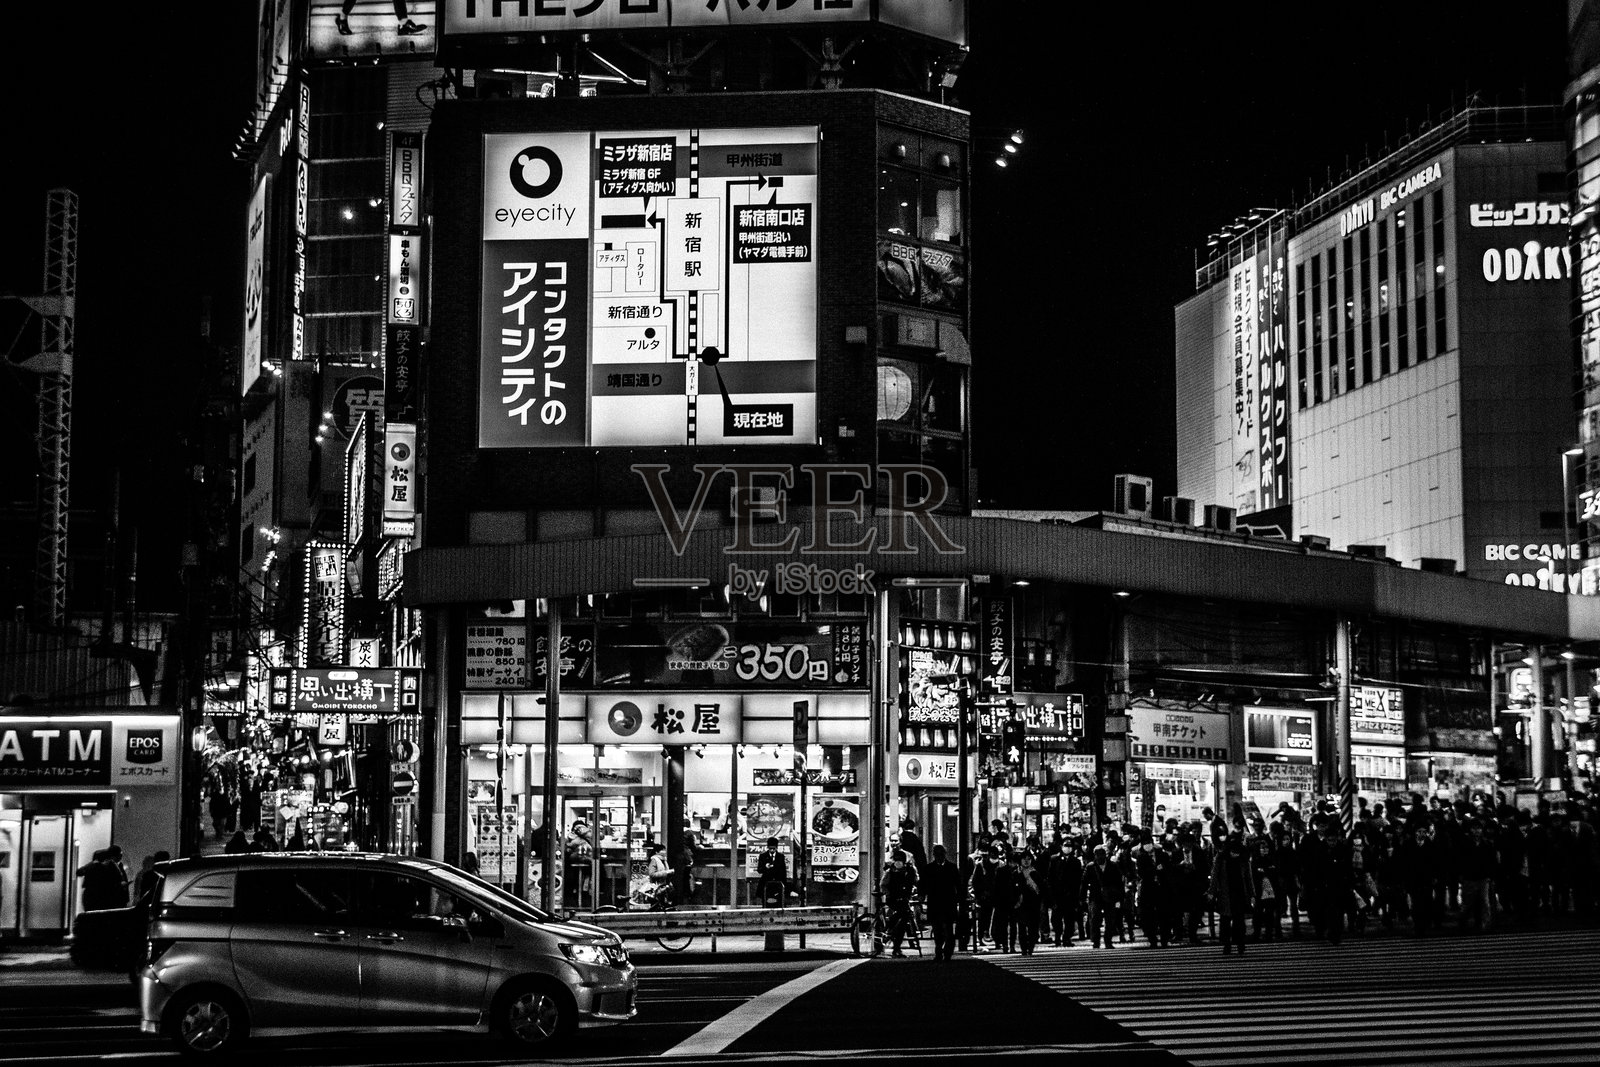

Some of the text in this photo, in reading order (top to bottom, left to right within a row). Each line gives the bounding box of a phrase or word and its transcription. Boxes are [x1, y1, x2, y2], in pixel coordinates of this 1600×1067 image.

[603, 143, 673, 162] ミラザ新宿店
[726, 152, 783, 168] 甲州街道
[603, 167, 661, 180] ミラザ新宿 6F
[400, 151, 415, 223] BBQフェスタ
[602, 181, 675, 195] (アディダス向かい)
[1380, 187, 1398, 210] BIC
[1398, 162, 1442, 199] CAMERA
[494, 203, 576, 227] eyecity
[739, 208, 805, 227] 新宿南口店
[684, 211, 702, 278] 新宿駅
[738, 232, 792, 244] 甲州街道沿い
[738, 245, 809, 259] (ヤマダ電機手前)
[892, 243, 916, 262] BBQ
[636, 248, 645, 286] ロータリー
[608, 305, 663, 320] 新宿通り
[501, 262, 538, 427] アイシティ
[541, 262, 567, 427] コンタクトの
[626, 339, 660, 351] アルタ
[607, 373, 663, 388] 靖国通り
[733, 412, 784, 429] 現在地
[390, 465, 409, 502] 松屋
[1485, 544, 1520, 561] BIC
[359, 641, 372, 665] 炭火
[736, 643, 829, 681] 350円
[273, 675, 288, 705] 新宿
[298, 676, 393, 703] 思い出横丁
[402, 677, 417, 706] 西口
[651, 703, 721, 735] 松屋
[1153, 723, 1206, 739] 甲南チケット
[0, 729, 102, 761] ATM
[129, 737, 159, 748] EPOS
[120, 767, 168, 776] エポスカード
[928, 761, 957, 779] 松屋
[813, 855, 829, 863] 630
